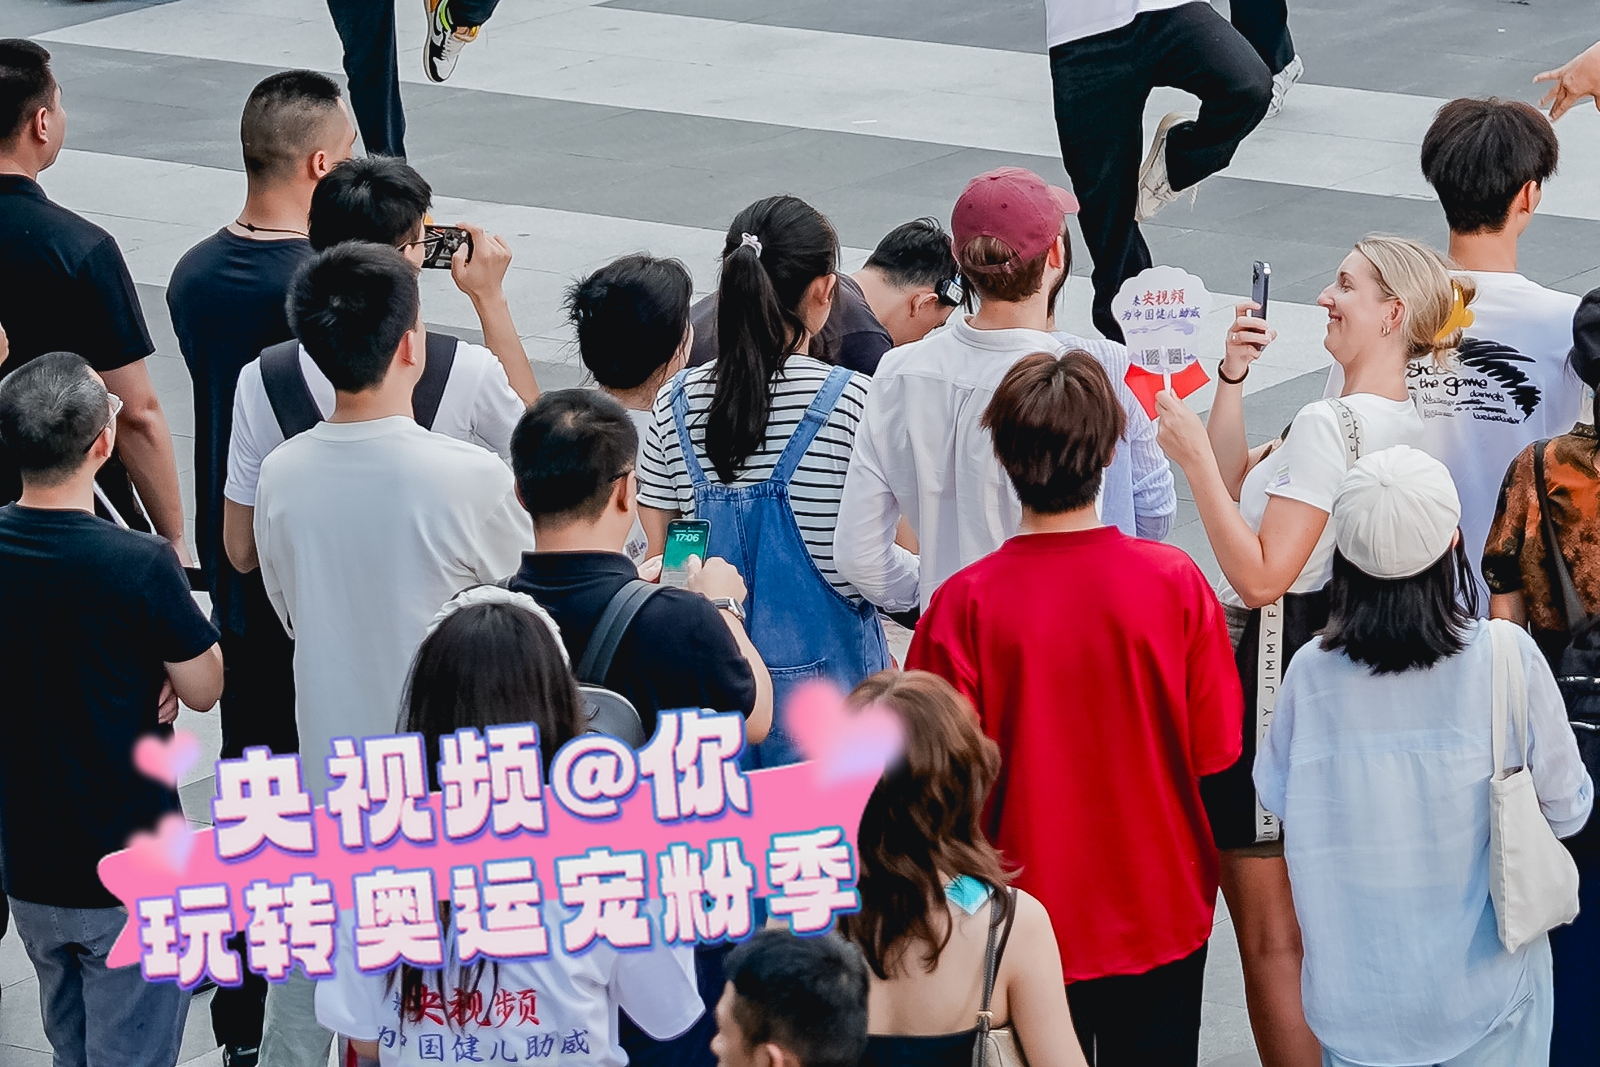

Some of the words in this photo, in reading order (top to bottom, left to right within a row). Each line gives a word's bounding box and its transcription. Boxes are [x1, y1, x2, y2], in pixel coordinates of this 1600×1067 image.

[1419, 378, 1439, 389] the
[1443, 376, 1488, 397] game
[675, 533, 700, 542] 17:06
[1264, 628, 1277, 694] JIMMY
